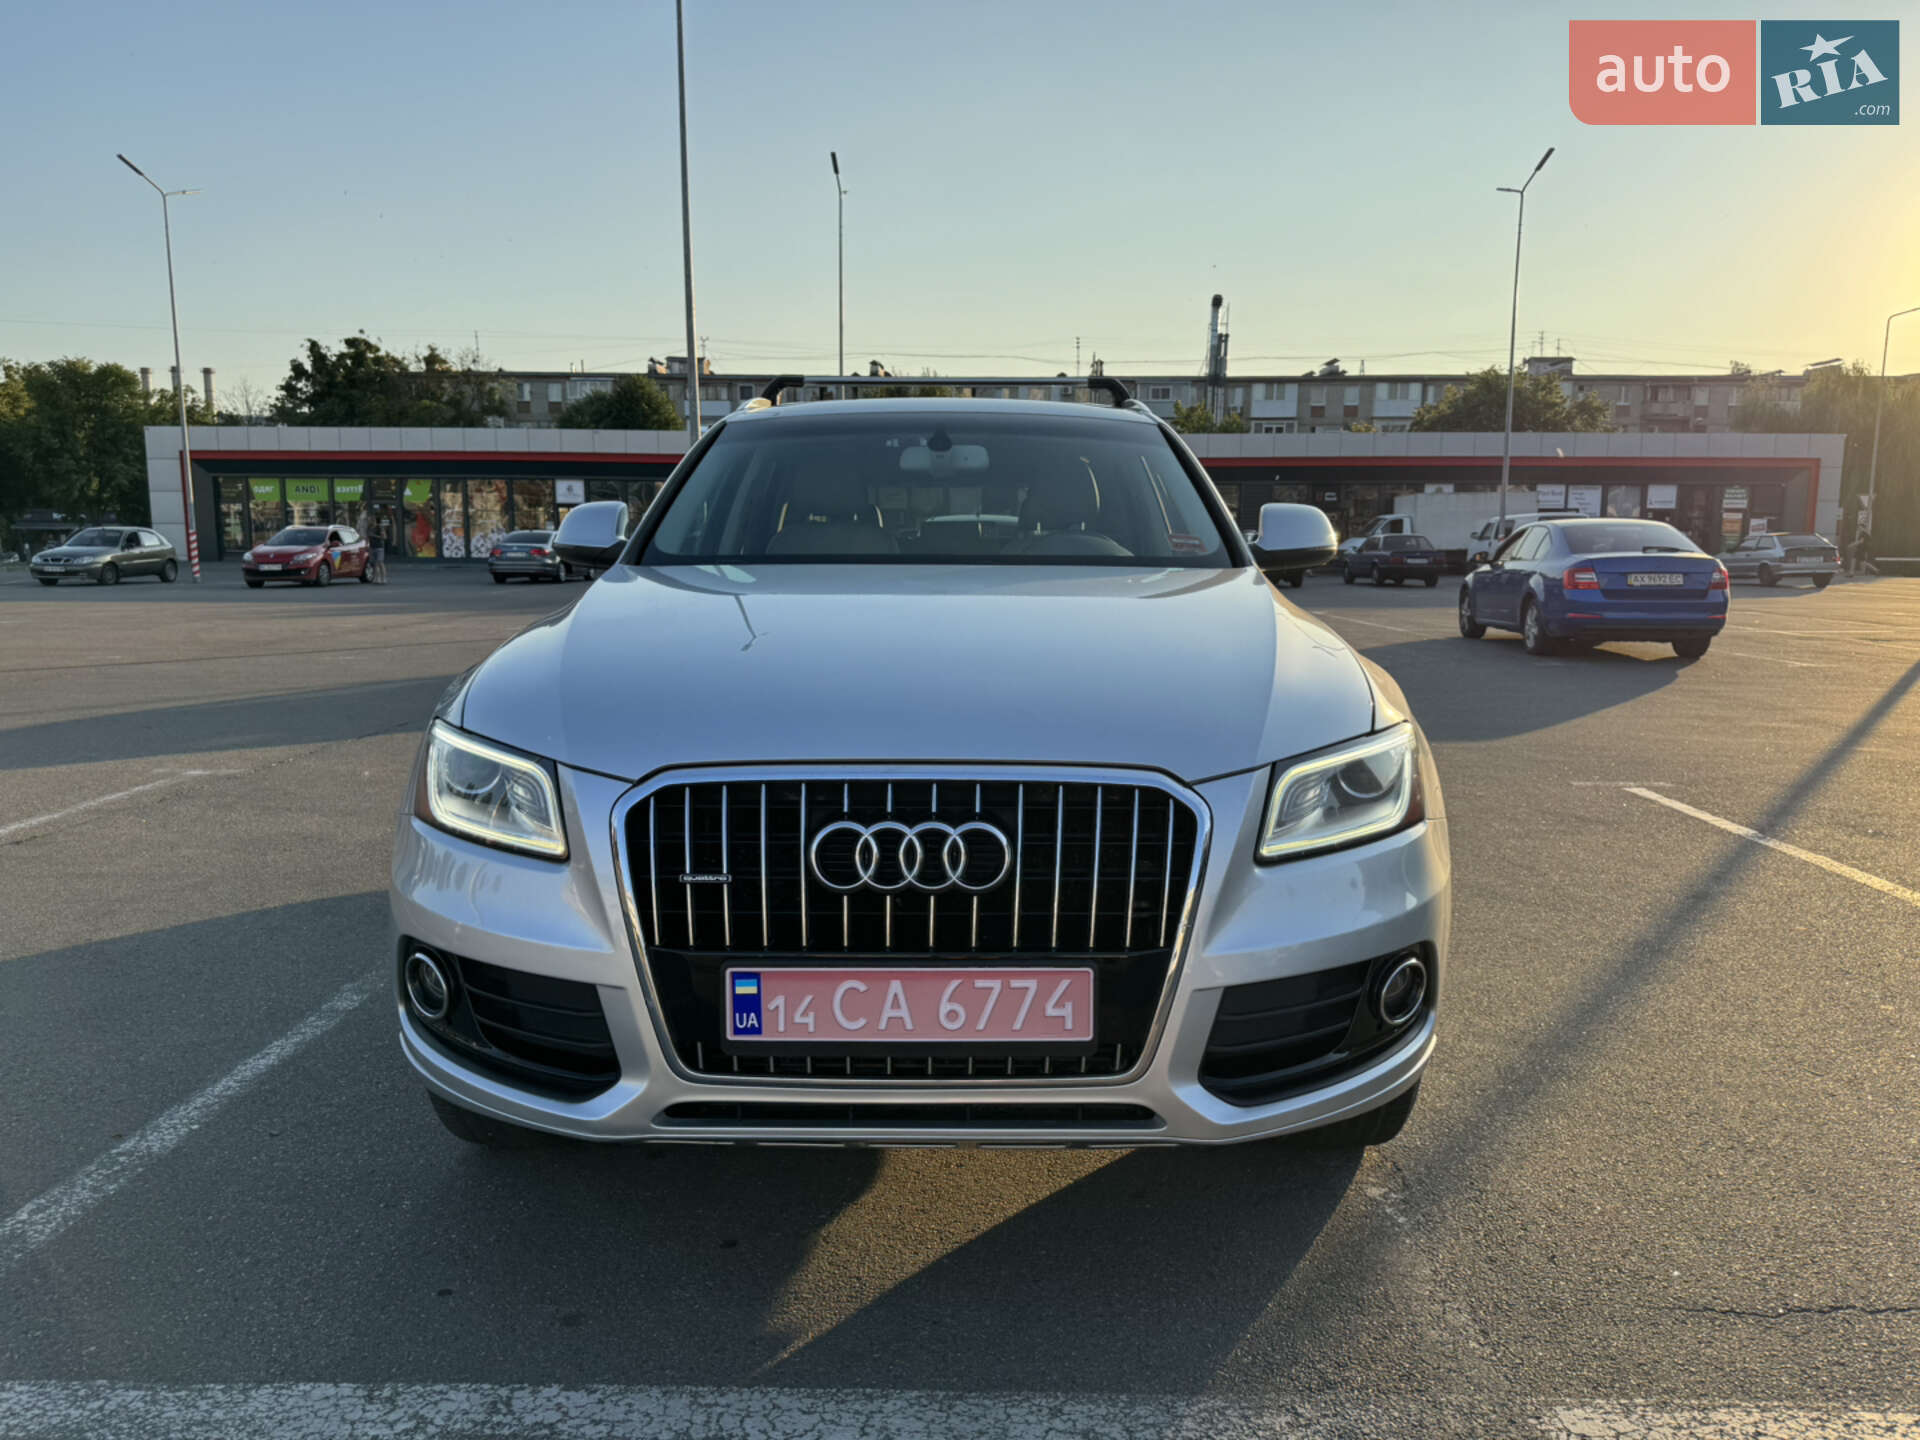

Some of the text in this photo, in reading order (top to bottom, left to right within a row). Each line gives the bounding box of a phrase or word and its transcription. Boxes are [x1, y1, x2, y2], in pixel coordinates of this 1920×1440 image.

[735, 1012, 760, 1029] UA
[767, 979, 1073, 1033] 14 CA 6774
